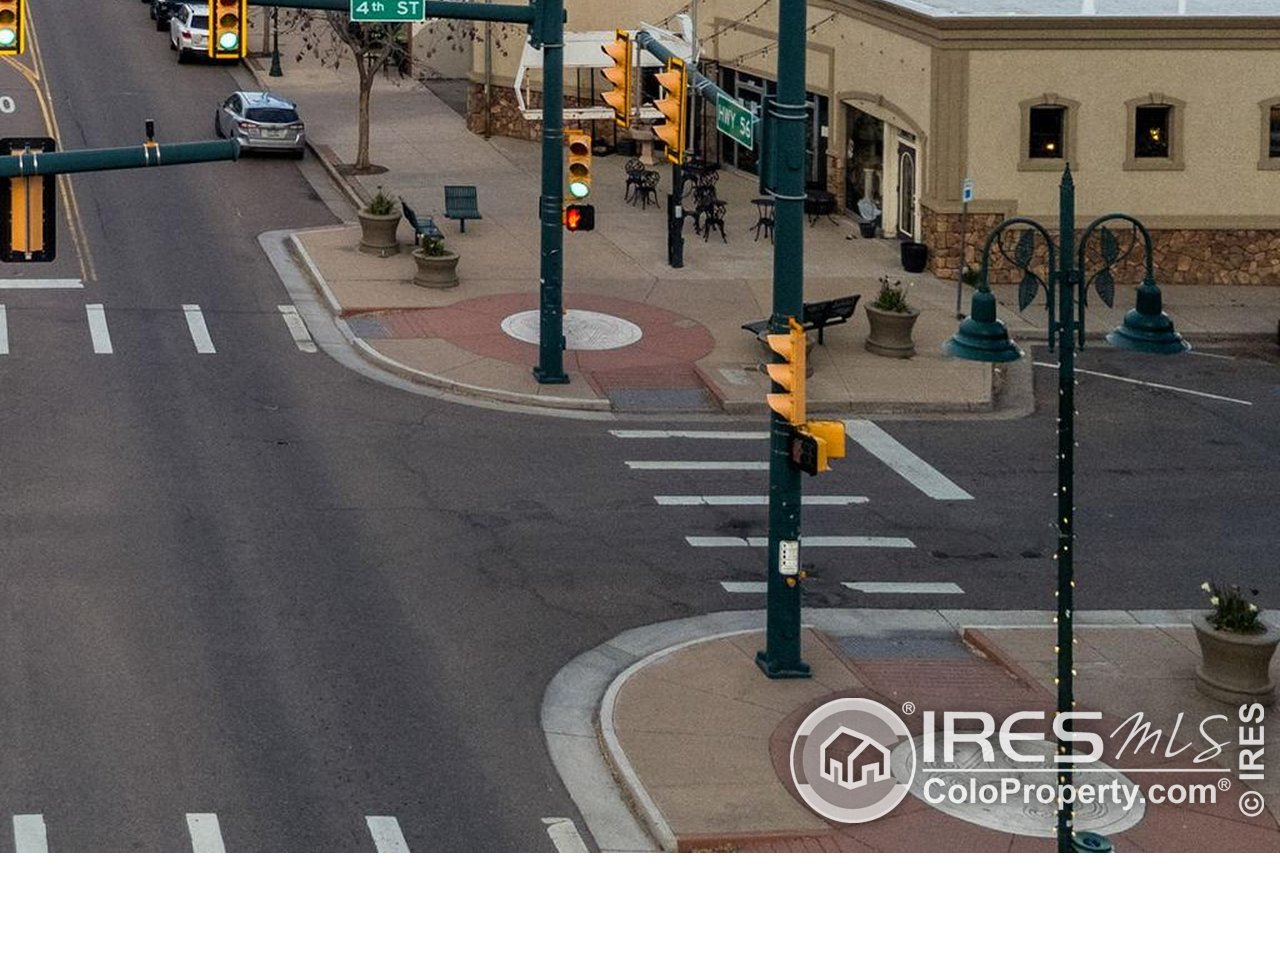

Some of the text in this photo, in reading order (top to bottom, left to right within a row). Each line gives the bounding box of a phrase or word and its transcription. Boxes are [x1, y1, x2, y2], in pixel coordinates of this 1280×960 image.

[355, 1, 419, 15] 4th ST
[719, 103, 736, 129] HWY
